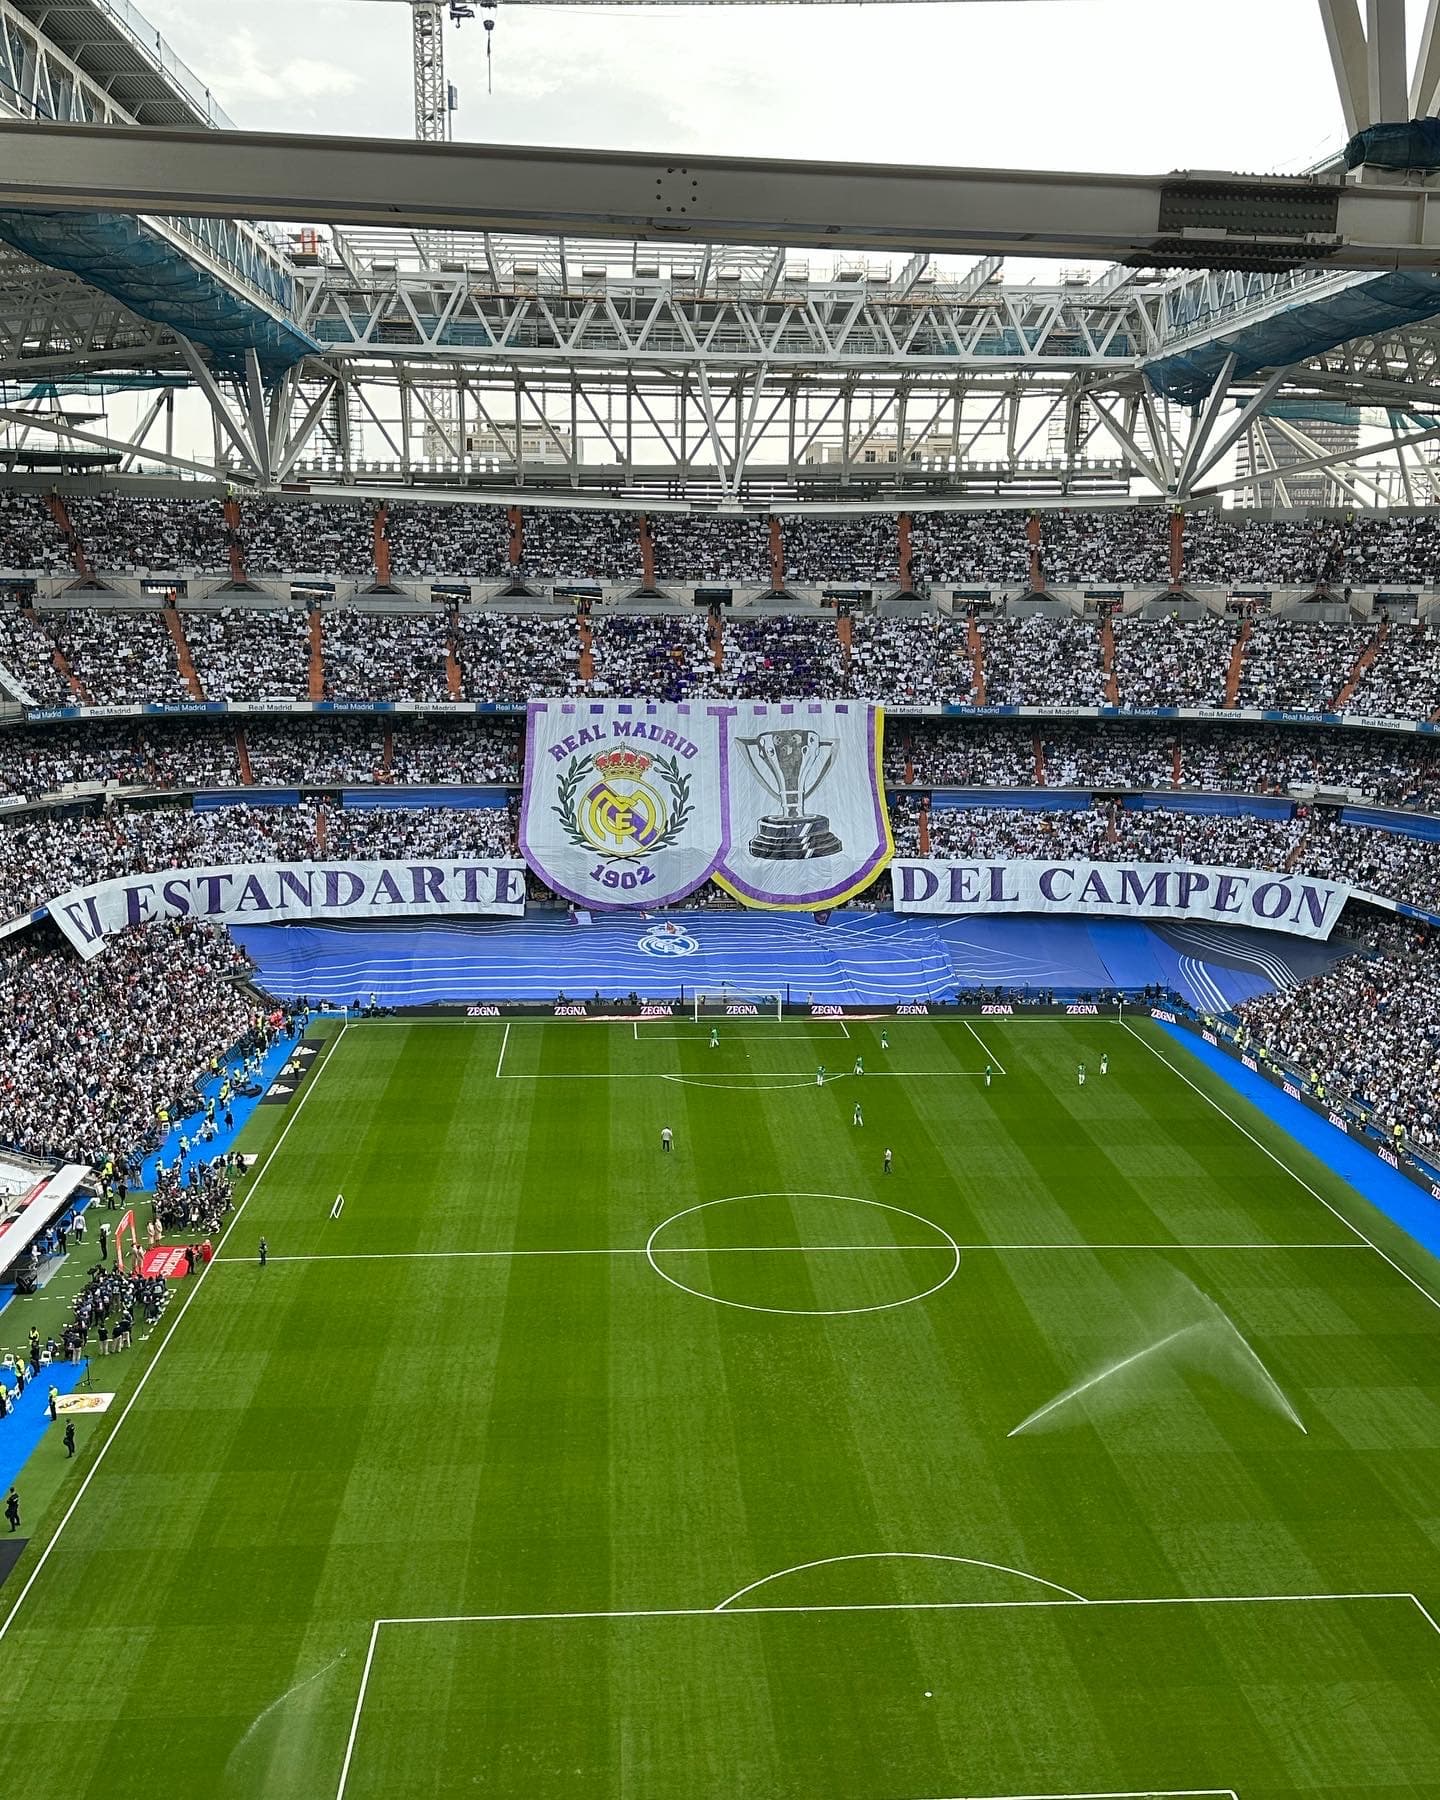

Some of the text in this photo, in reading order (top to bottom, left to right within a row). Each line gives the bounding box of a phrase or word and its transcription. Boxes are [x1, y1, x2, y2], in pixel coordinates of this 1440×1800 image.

[28, 710, 61, 720] Real Madrid
[105, 707, 131, 715] Madrid
[1135, 708, 1158, 716] Madrid
[1216, 711, 1241, 719] Madrid
[1282, 712, 1322, 722] Real Madrid
[1361, 719, 1400, 729] Real Madrid
[548, 721, 699, 762] REAL MADRID
[589, 865, 656, 889] 1902
[898, 867, 1335, 928] DEL CAMPEÓN
[63, 866, 527, 943] EL ESTANDARTE
[467, 1006, 500, 1016] ZEGNA
[554, 1006, 587, 1015] ZEGNA
[640, 1006, 673, 1015] ZEGNA
[726, 1006, 758, 1014] ZEGNA
[811, 1006, 843, 1014] ZEGNA
[896, 1005, 928, 1014] ZEGNA
[981, 1005, 1013, 1014] ZEGNA
[1066, 1005, 1098, 1014] ZEGNA
[1151, 1008, 1177, 1024] ZEGNA
[1378, 1145, 1399, 1170] ZEGNA
